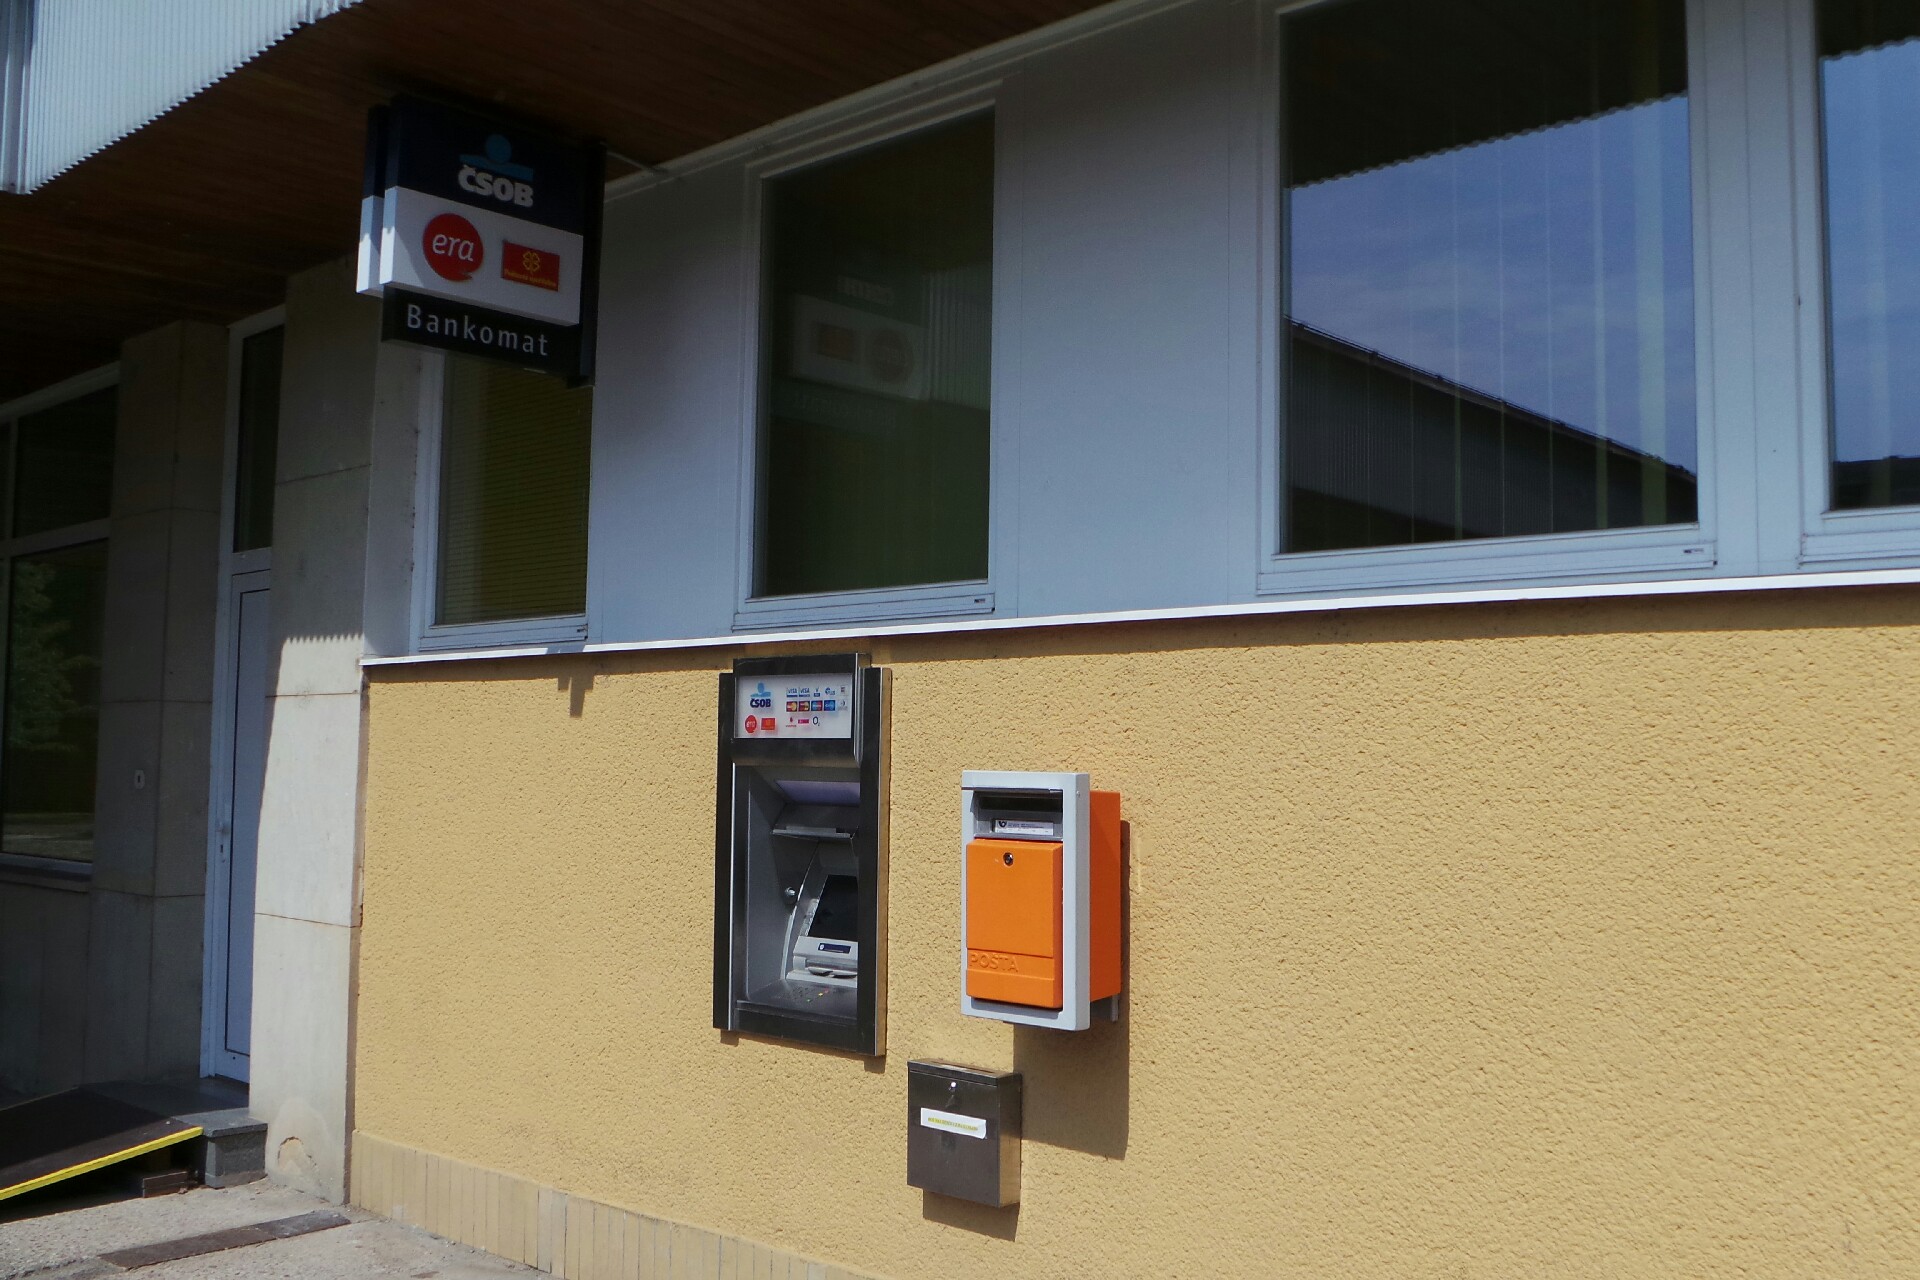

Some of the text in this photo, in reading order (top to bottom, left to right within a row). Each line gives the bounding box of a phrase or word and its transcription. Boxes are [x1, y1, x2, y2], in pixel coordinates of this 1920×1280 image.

[458, 164, 534, 208] ČSOB
[432, 233, 475, 262] era
[407, 303, 549, 357] Bankomat
